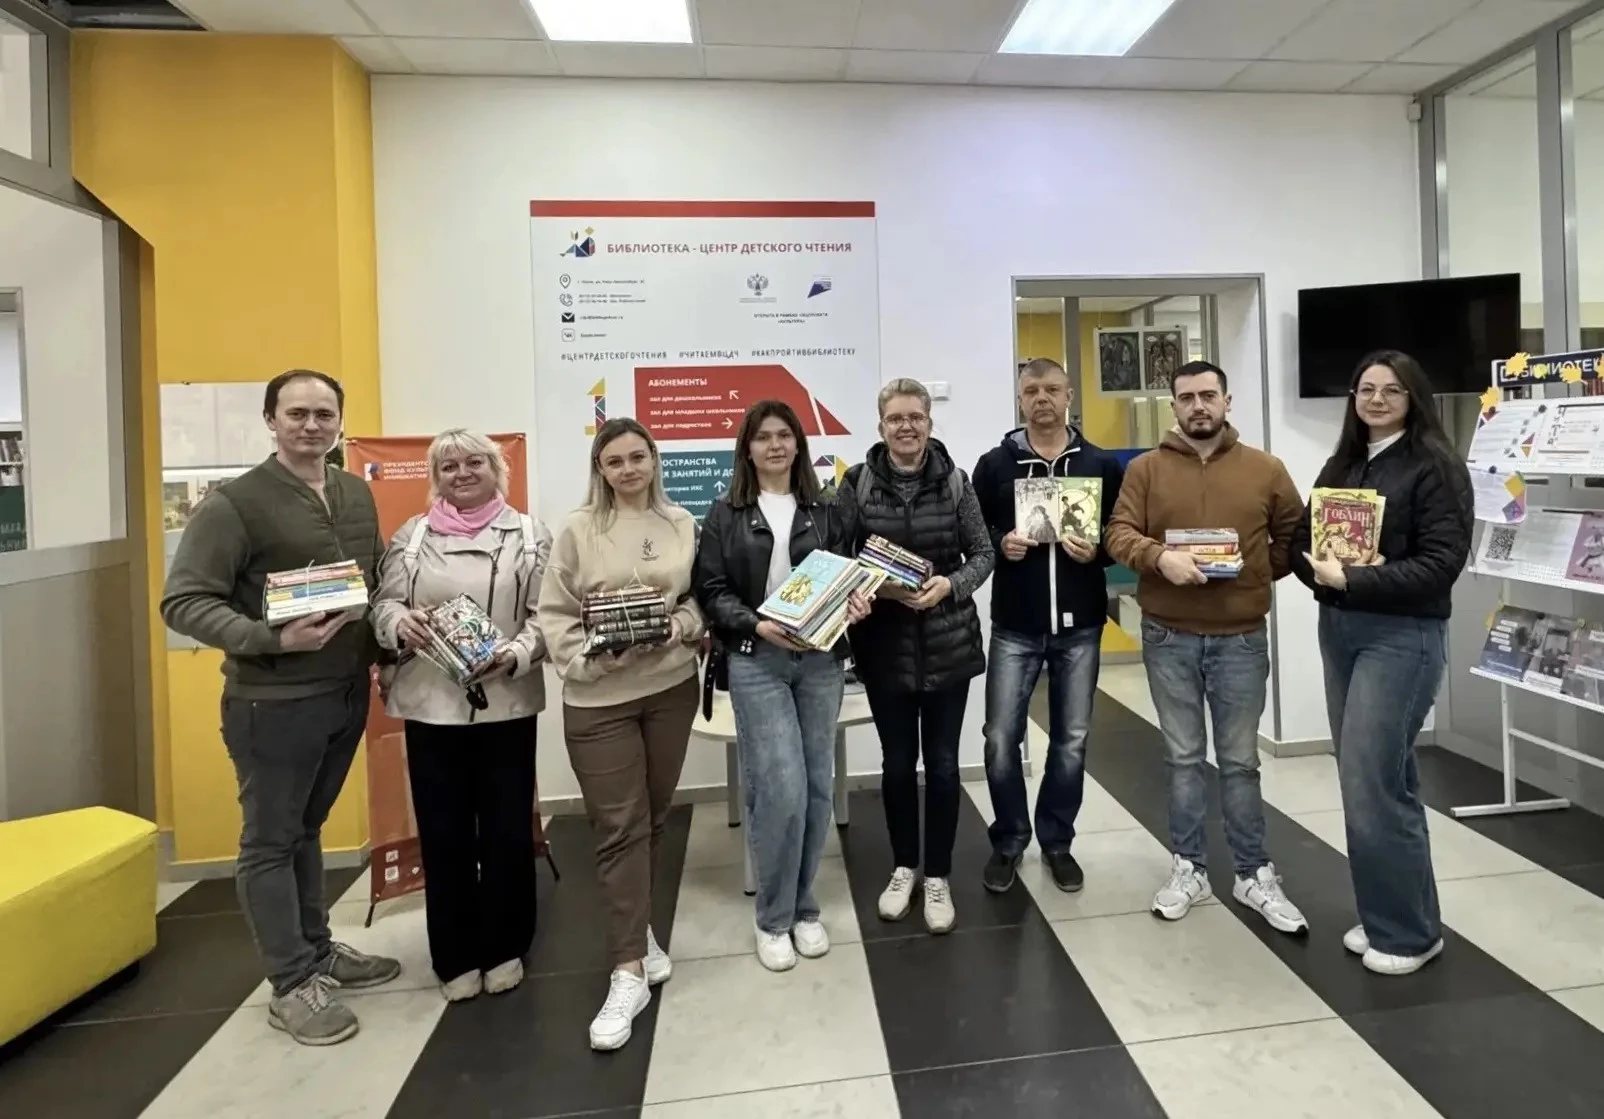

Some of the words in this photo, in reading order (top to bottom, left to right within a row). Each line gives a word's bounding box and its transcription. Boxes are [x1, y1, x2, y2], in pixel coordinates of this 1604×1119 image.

[607, 243, 690, 253] БИБЛИОТЕКА
[700, 243, 737, 255] ЦЕНТР
[740, 243, 802, 255] ДЕТСКОГО
[805, 242, 852, 252] ЧТЕНИЯ
[561, 351, 667, 362] #ЦЕНТРДЕТСКОГОЧТЕНИЯ
[648, 378, 708, 387] АБОНЕМЕНТЫ
[662, 457, 717, 467] ОСТРАНСТВА
[671, 467, 712, 478] ЗАНЯТИЙ
[713, 469, 720, 477] И
